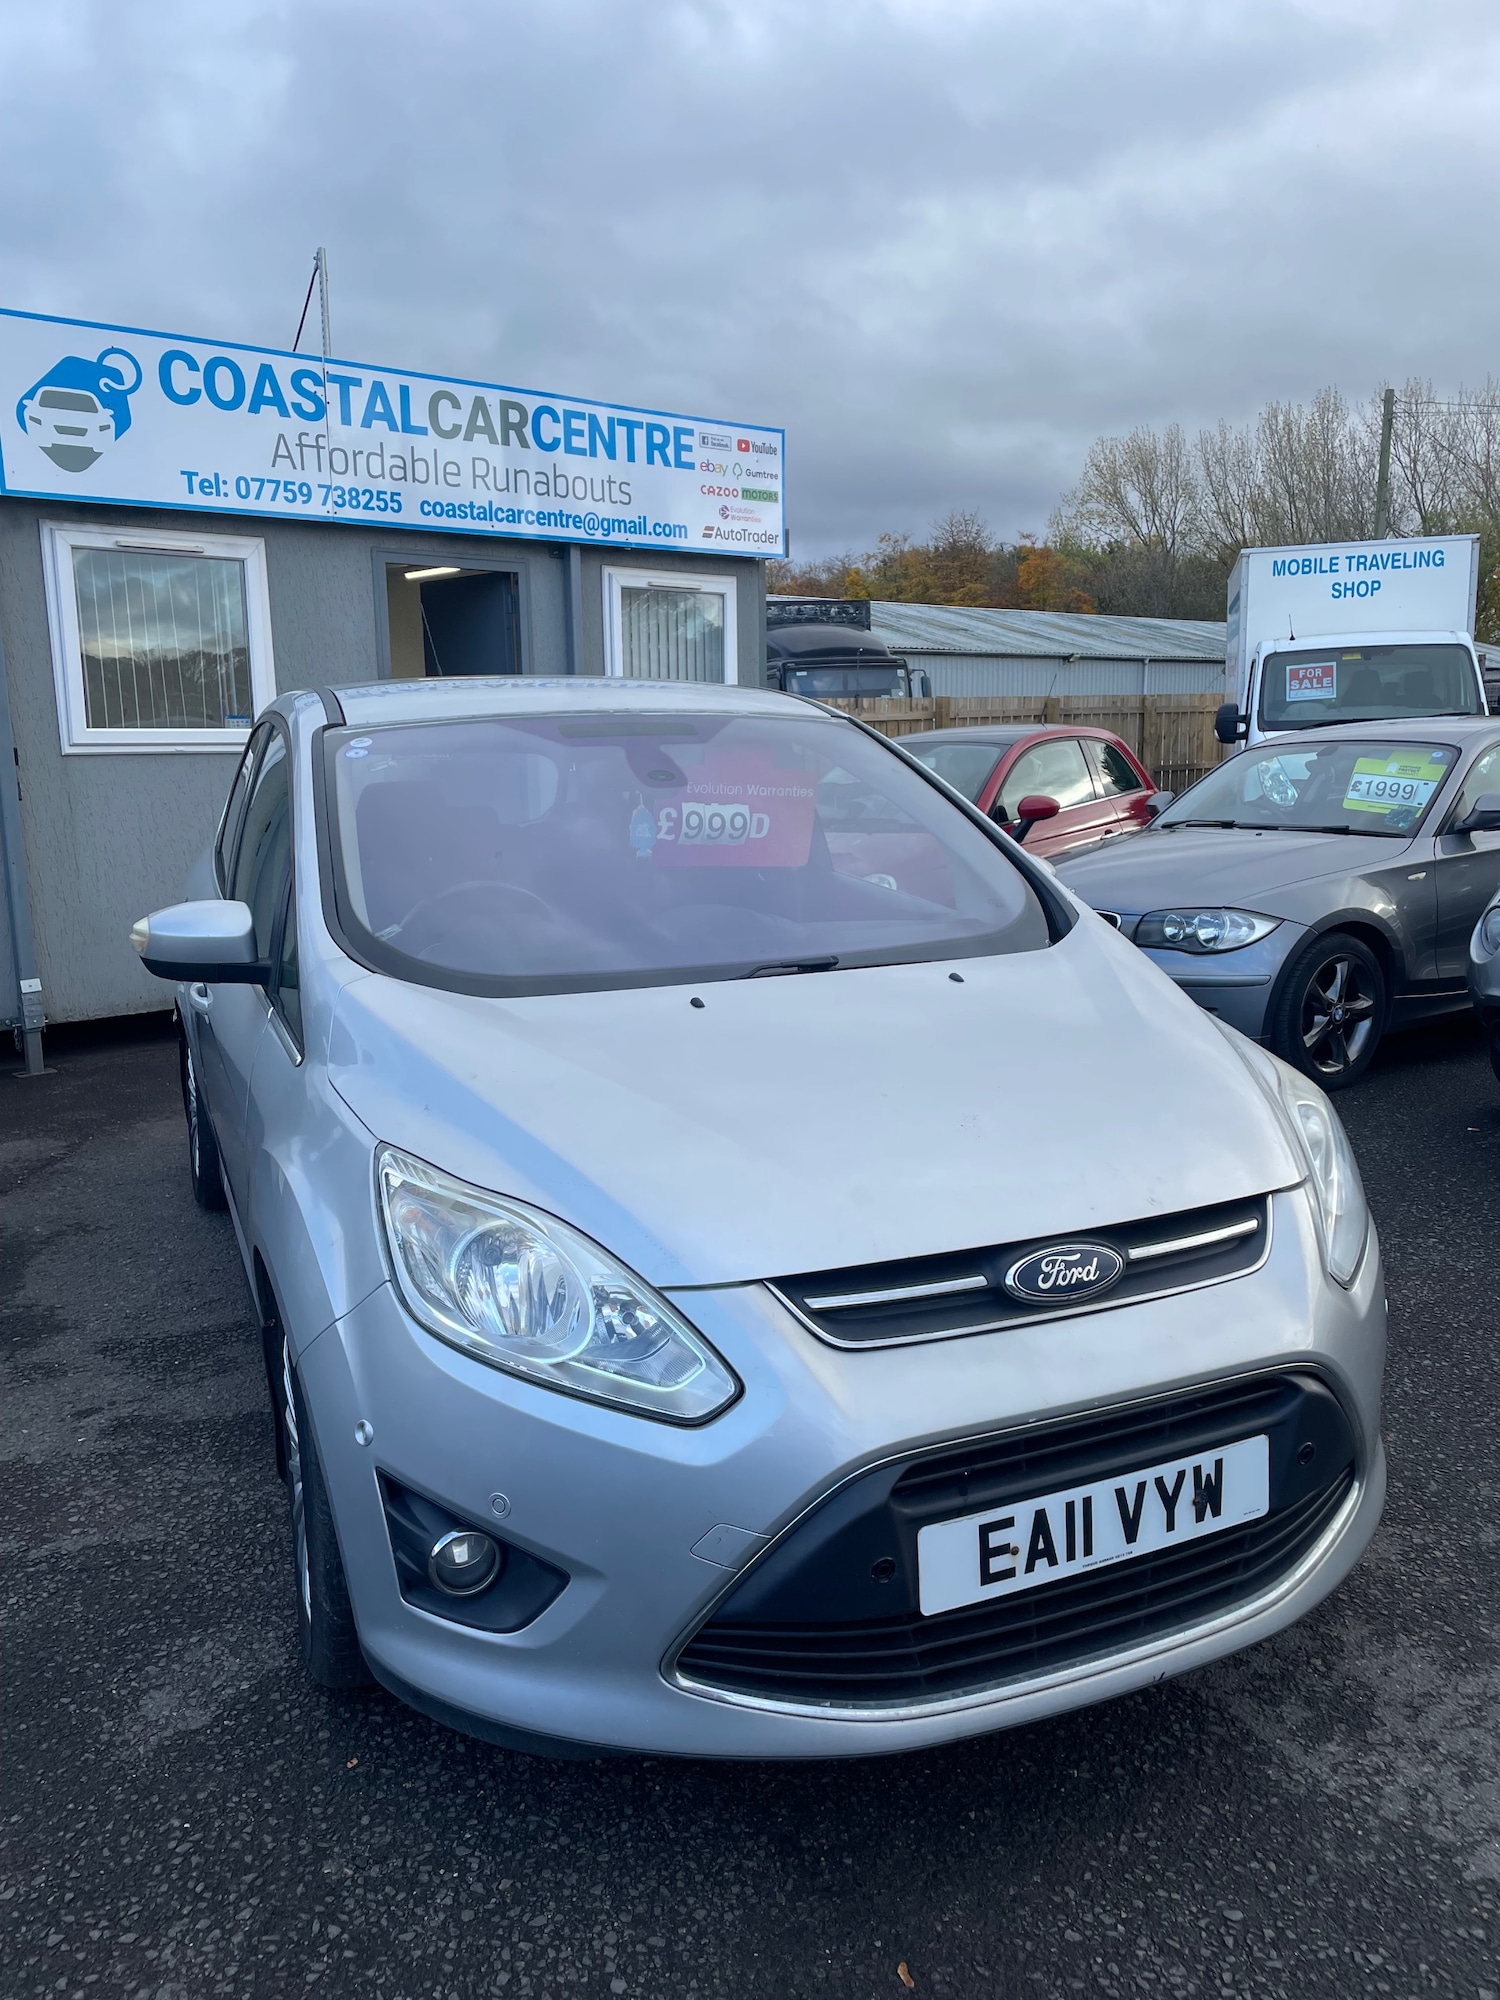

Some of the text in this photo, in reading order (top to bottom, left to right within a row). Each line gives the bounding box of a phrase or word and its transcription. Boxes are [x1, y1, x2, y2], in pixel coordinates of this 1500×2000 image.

[158, 349, 696, 470] COASTALCARCENTRE
[751, 441, 778, 456] YouTube
[271, 431, 632, 506] Affordable Runabouts
[700, 458, 728, 476] ebay
[746, 468, 779, 480] Gumtree
[180, 470, 403, 514] Tel: 07759 738255
[700, 484, 739, 498] CAZOO
[420, 497, 689, 541] coastalcarcentre@gmail.com
[730, 506, 755, 515] Evolution
[714, 527, 779, 544] AutoTrader
[1272, 549, 1445, 577] MOBILE TRAVELING
[1331, 580, 1381, 599] SHOP
[1299, 668, 1322, 678] FOR
[1290, 677, 1332, 690] SALE
[687, 782, 814, 798] Evolution Warranties
[1350, 780, 1415, 800] £1999
[1036, 1252, 1100, 1290] Ford
[978, 1457, 1224, 1587] EA11 VYW
